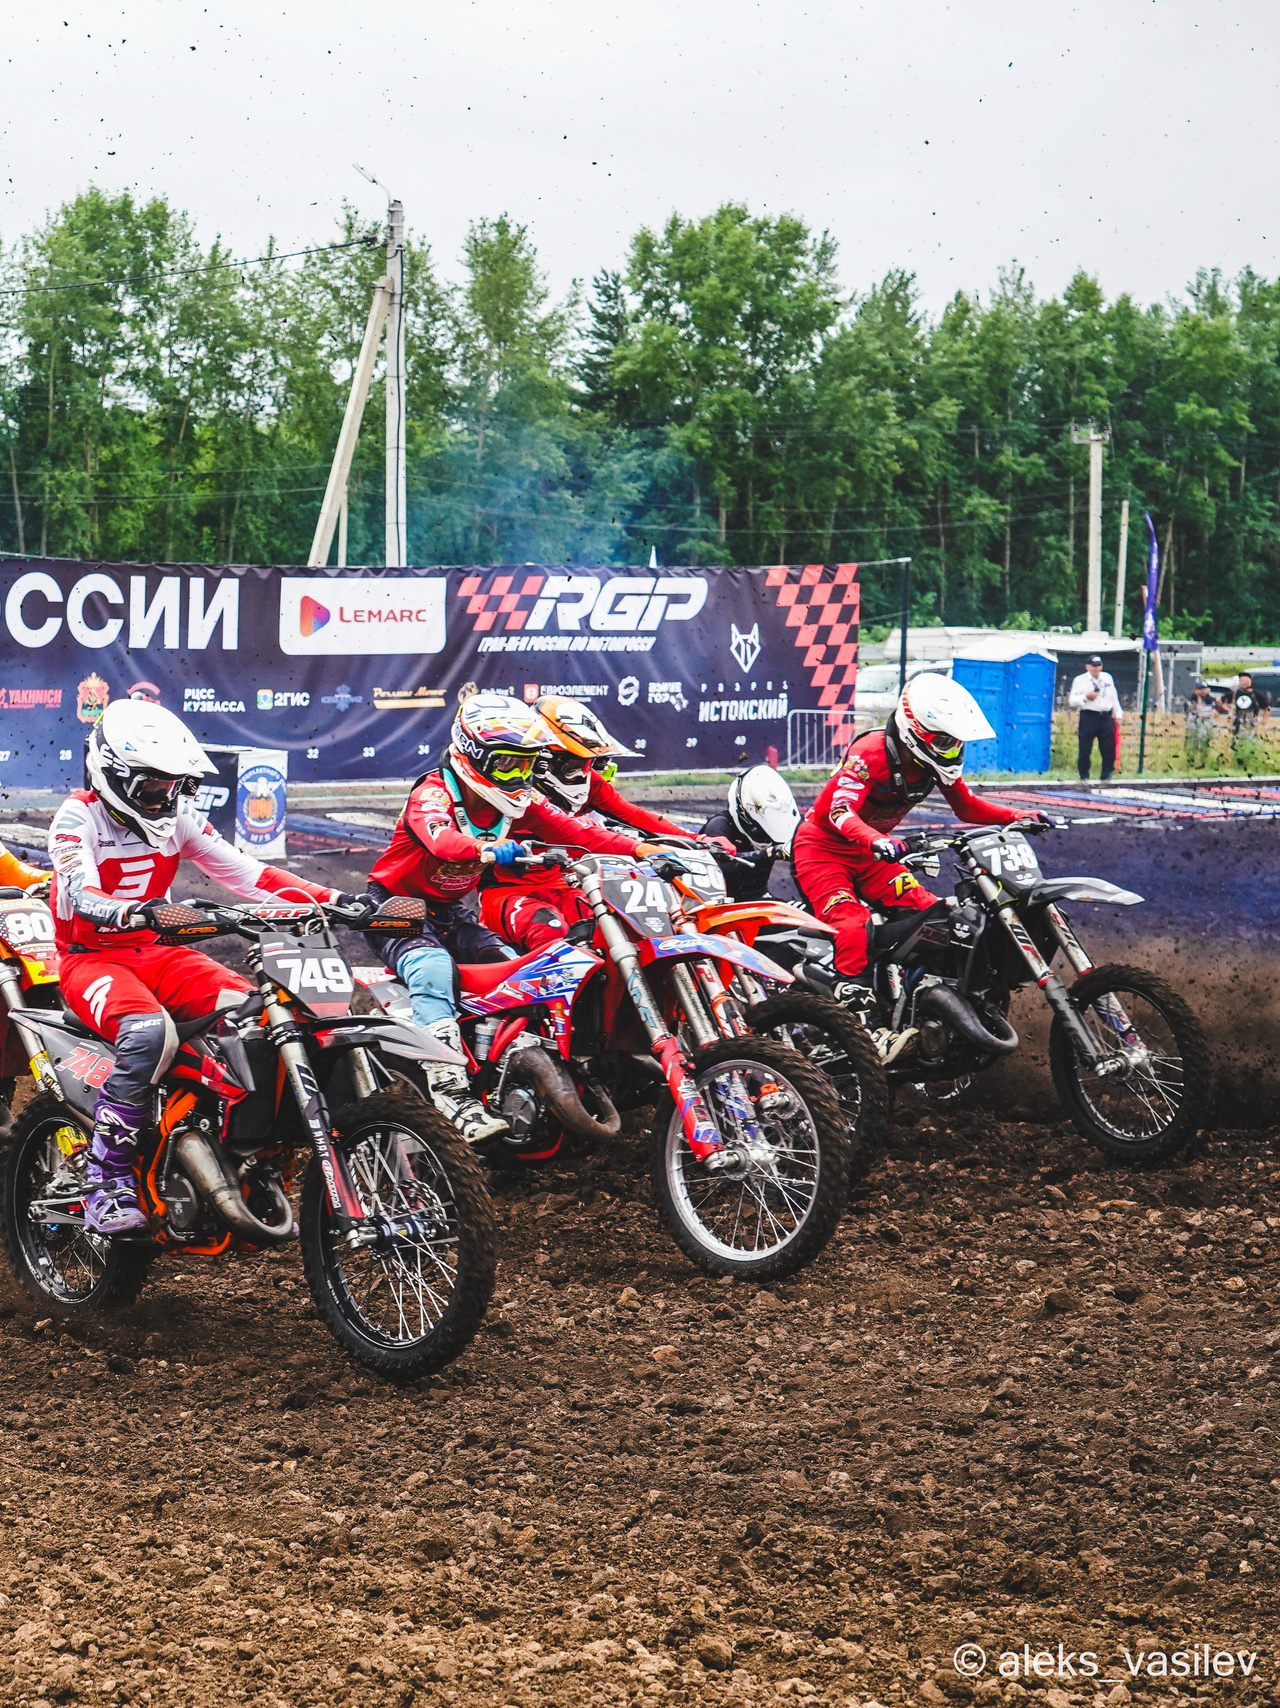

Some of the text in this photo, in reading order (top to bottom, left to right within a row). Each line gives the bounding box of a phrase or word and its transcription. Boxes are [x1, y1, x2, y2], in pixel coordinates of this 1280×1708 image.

[525, 576, 709, 631] RGP
[528, 636, 572, 652] РОССИИ
[570, 637, 587, 652] ПО
[8, 689, 62, 704] YAKHNICH
[184, 688, 215, 700] РЦСС
[274, 692, 310, 706] 2ГИС
[183, 700, 245, 712] КУЗБАССА
[698, 693, 788, 722] ИСТОКСКИЙ
[306, 748, 320, 759] 32
[363, 747, 375, 757] 33
[418, 744, 430, 755] 34
[982, 844, 1039, 876] 738
[620, 880, 668, 914] 24
[79, 900, 116, 918] SHOT
[252, 908, 313, 920] WRP
[5, 912, 56, 944] 80
[275, 957, 355, 994] 749
